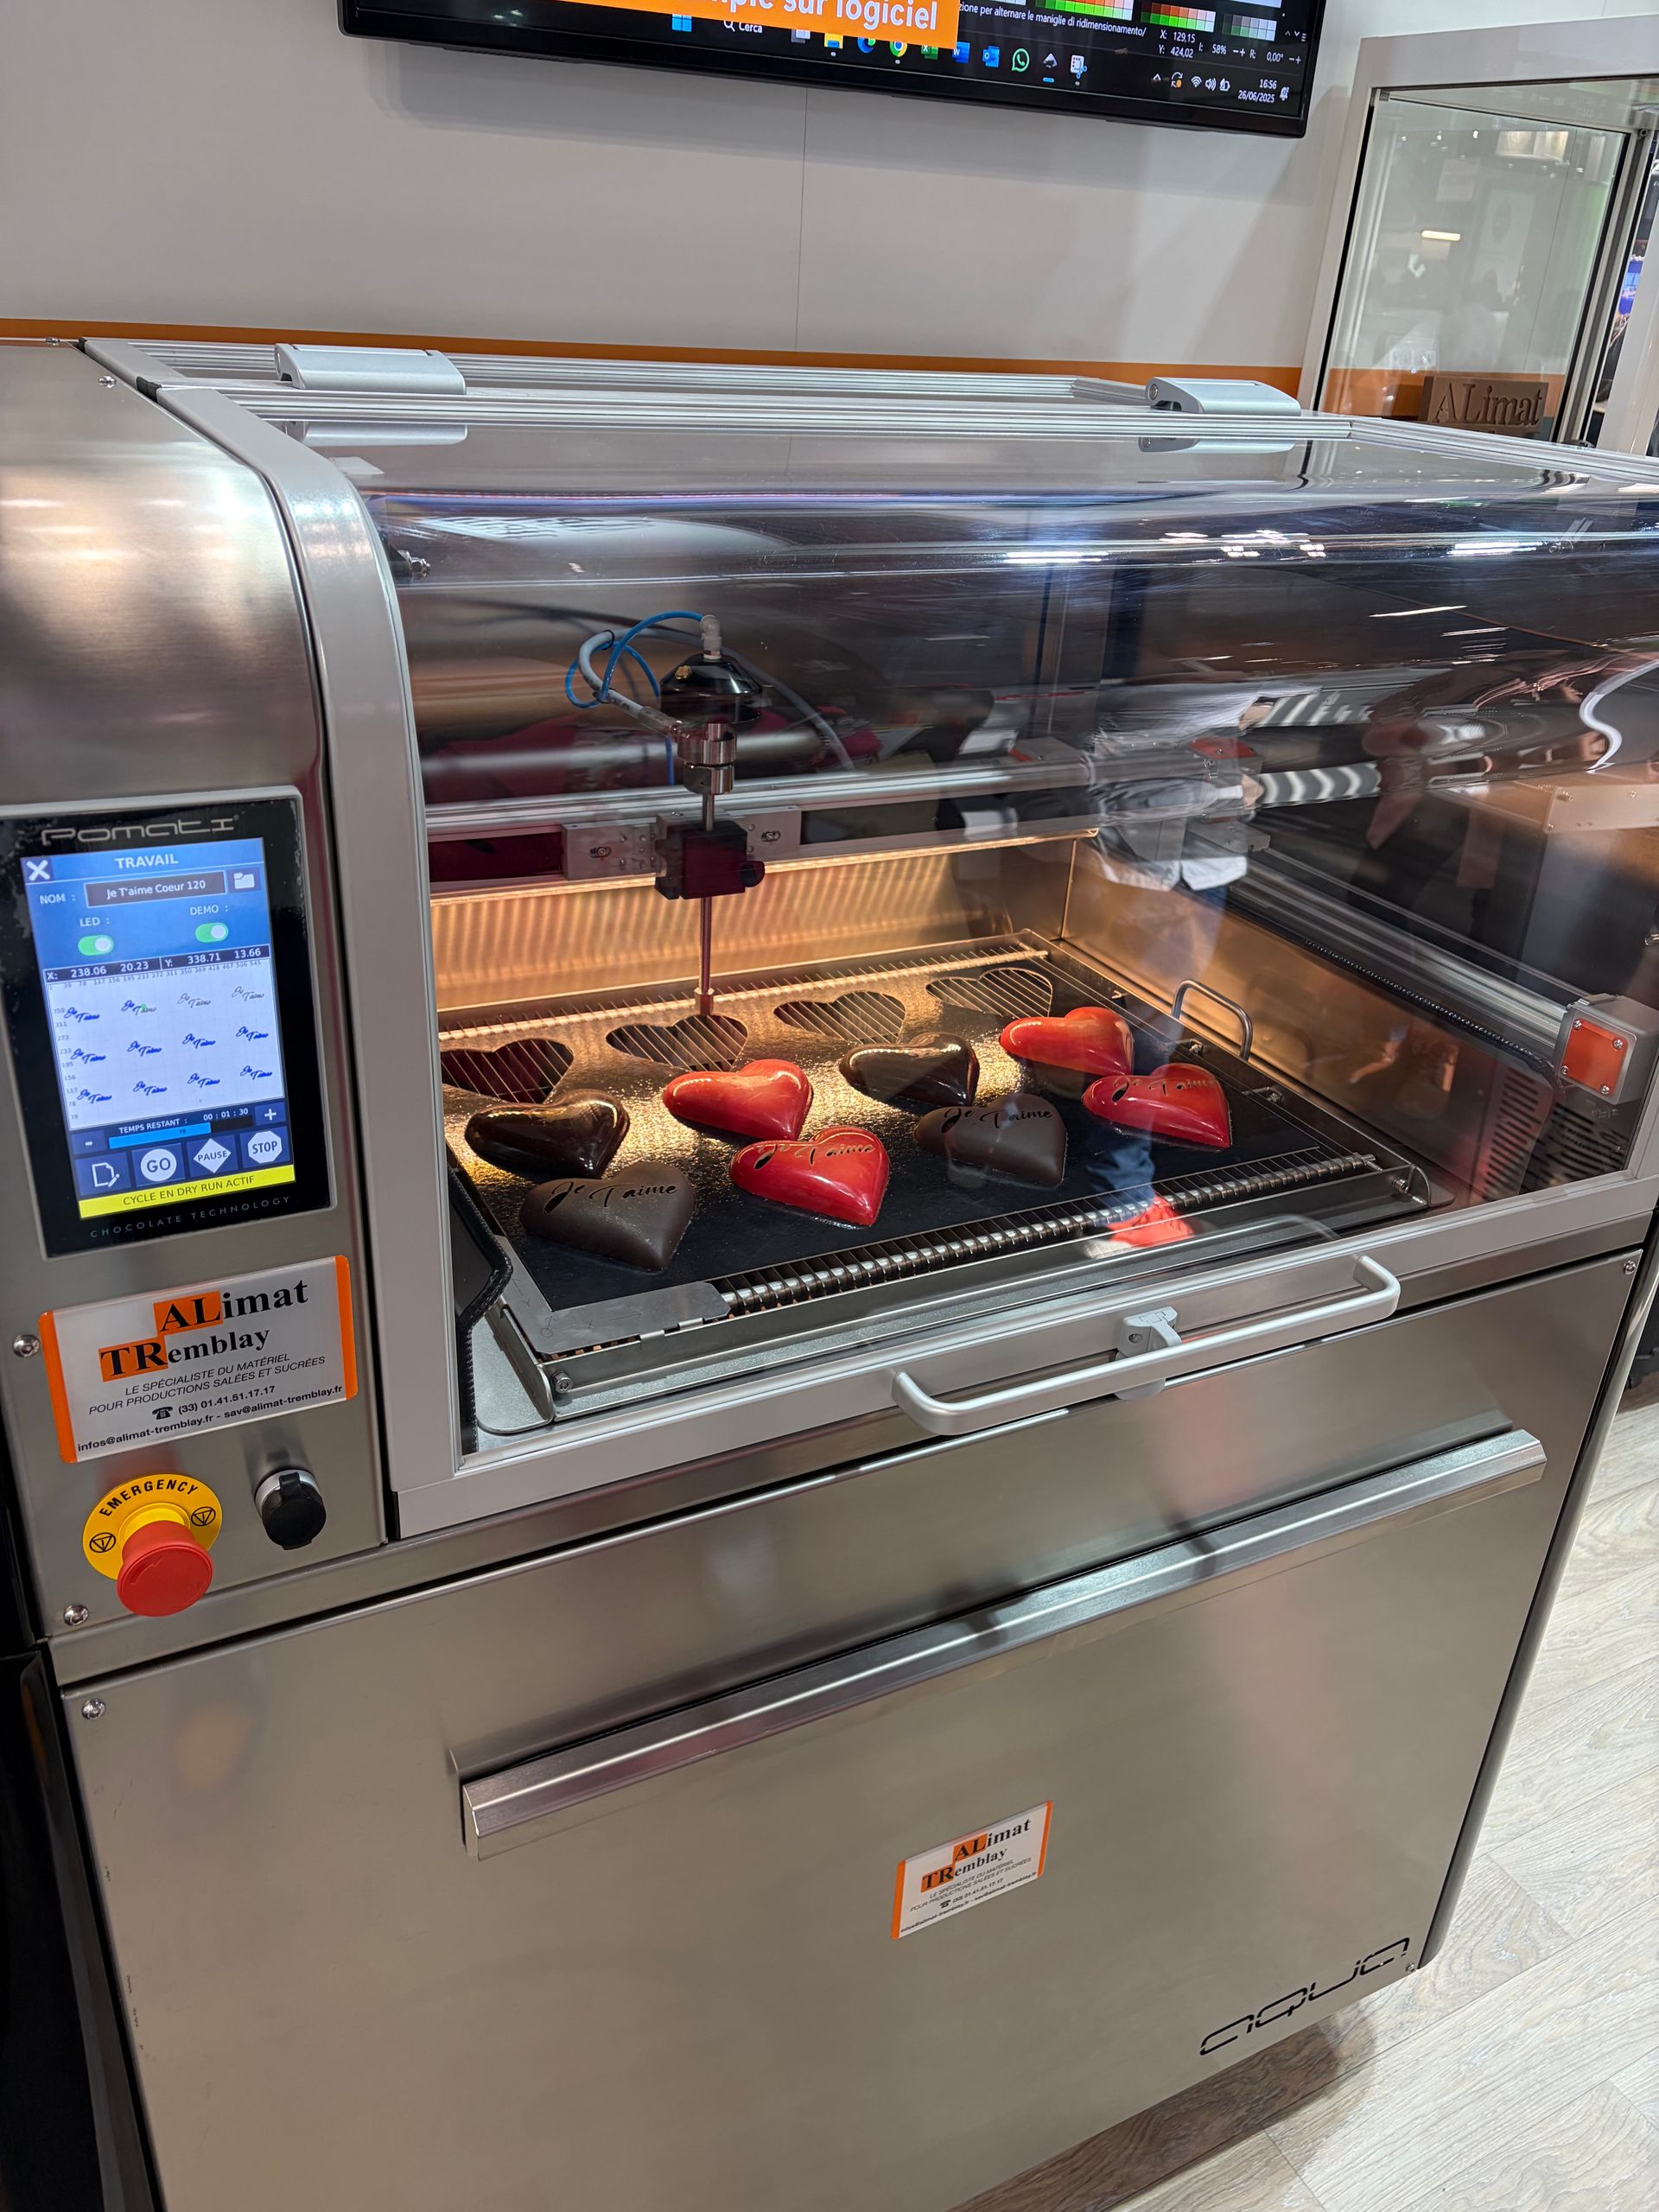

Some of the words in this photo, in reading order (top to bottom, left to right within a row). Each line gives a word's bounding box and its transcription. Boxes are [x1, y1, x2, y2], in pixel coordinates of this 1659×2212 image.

[739, 22, 762, 33] Cerca
[836, 0, 938, 30] logiciel
[980, 8, 993, 16] per
[995, 8, 1026, 20] alternare
[1027, 11, 1034, 21] le
[1035, 13, 1066, 26] maniglie
[1068, 16, 1075, 26] di
[1173, 31, 1196, 43] 129,15
[1212, 44, 1227, 54] 58%
[1170, 47, 1193, 58] 424,02
[1237, 90, 1275, 103] 26/06/2025
[1259, 79, 1277, 90] 16:56
[1433, 382, 1542, 426] ALimat
[115, 853, 179, 869] TRAVAIL
[40, 893, 66, 905] NOM
[106, 887, 118, 900] Je
[119, 884, 153, 897] T'aime
[155, 881, 184, 893] Coeur
[187, 880, 206, 890] 120
[79, 916, 100, 927] LED
[189, 904, 219, 916] DEMO
[70, 966, 106, 978] 238.06
[120, 961, 149, 972] 20.23
[188, 952, 220, 964] 338.71
[234, 948, 261, 959] 13.66
[118, 1123, 144, 1134] TEMPS
[146, 1118, 180, 1130] RESTANT
[197, 1150, 228, 1161] PAUSE
[251, 1141, 278, 1154] STOP
[146, 1158, 171, 1173] GO
[123, 1192, 156, 1205] CYCLE
[160, 1190, 174, 1199] EN
[177, 1185, 198, 1196] DRY
[201, 1181, 223, 1192] RUN
[226, 1176, 255, 1187] ACTIF
[543, 1181, 585, 1215] Je
[90, 1216, 181, 1237] CHOCOLATE
[191, 1196, 290, 1220] TECHNOLOGY
[159, 1280, 308, 1332] ALimat
[100, 1327, 270, 1376] TRemblay
[89, 1401, 123, 1414] POUR
[126, 1382, 210, 1406] PRODUCTIONS
[213, 1371, 255, 1388] SALÉES
[258, 1368, 272, 1378] ET
[274, 1356, 326, 1374] SUCRÉES
[125, 1385, 139, 1395] LE
[143, 1370, 214, 1391] SPÉCIALISTE
[218, 1365, 233, 1376] DU
[237, 1353, 290, 1372] MATÉRIEL
[178, 1402, 198, 1415] (33)
[200, 1385, 276, 1408] 01.41.51.17.17
[78, 1414, 213, 1452] infos@alimat-tremblay.fr
[224, 1385, 343, 1419] sav@alimat-tremblay.fr
[99, 1479, 198, 1516] EMERGENCY
[955, 1818, 1032, 1860] ALimat
[922, 1848, 1007, 1890] TRemblay
